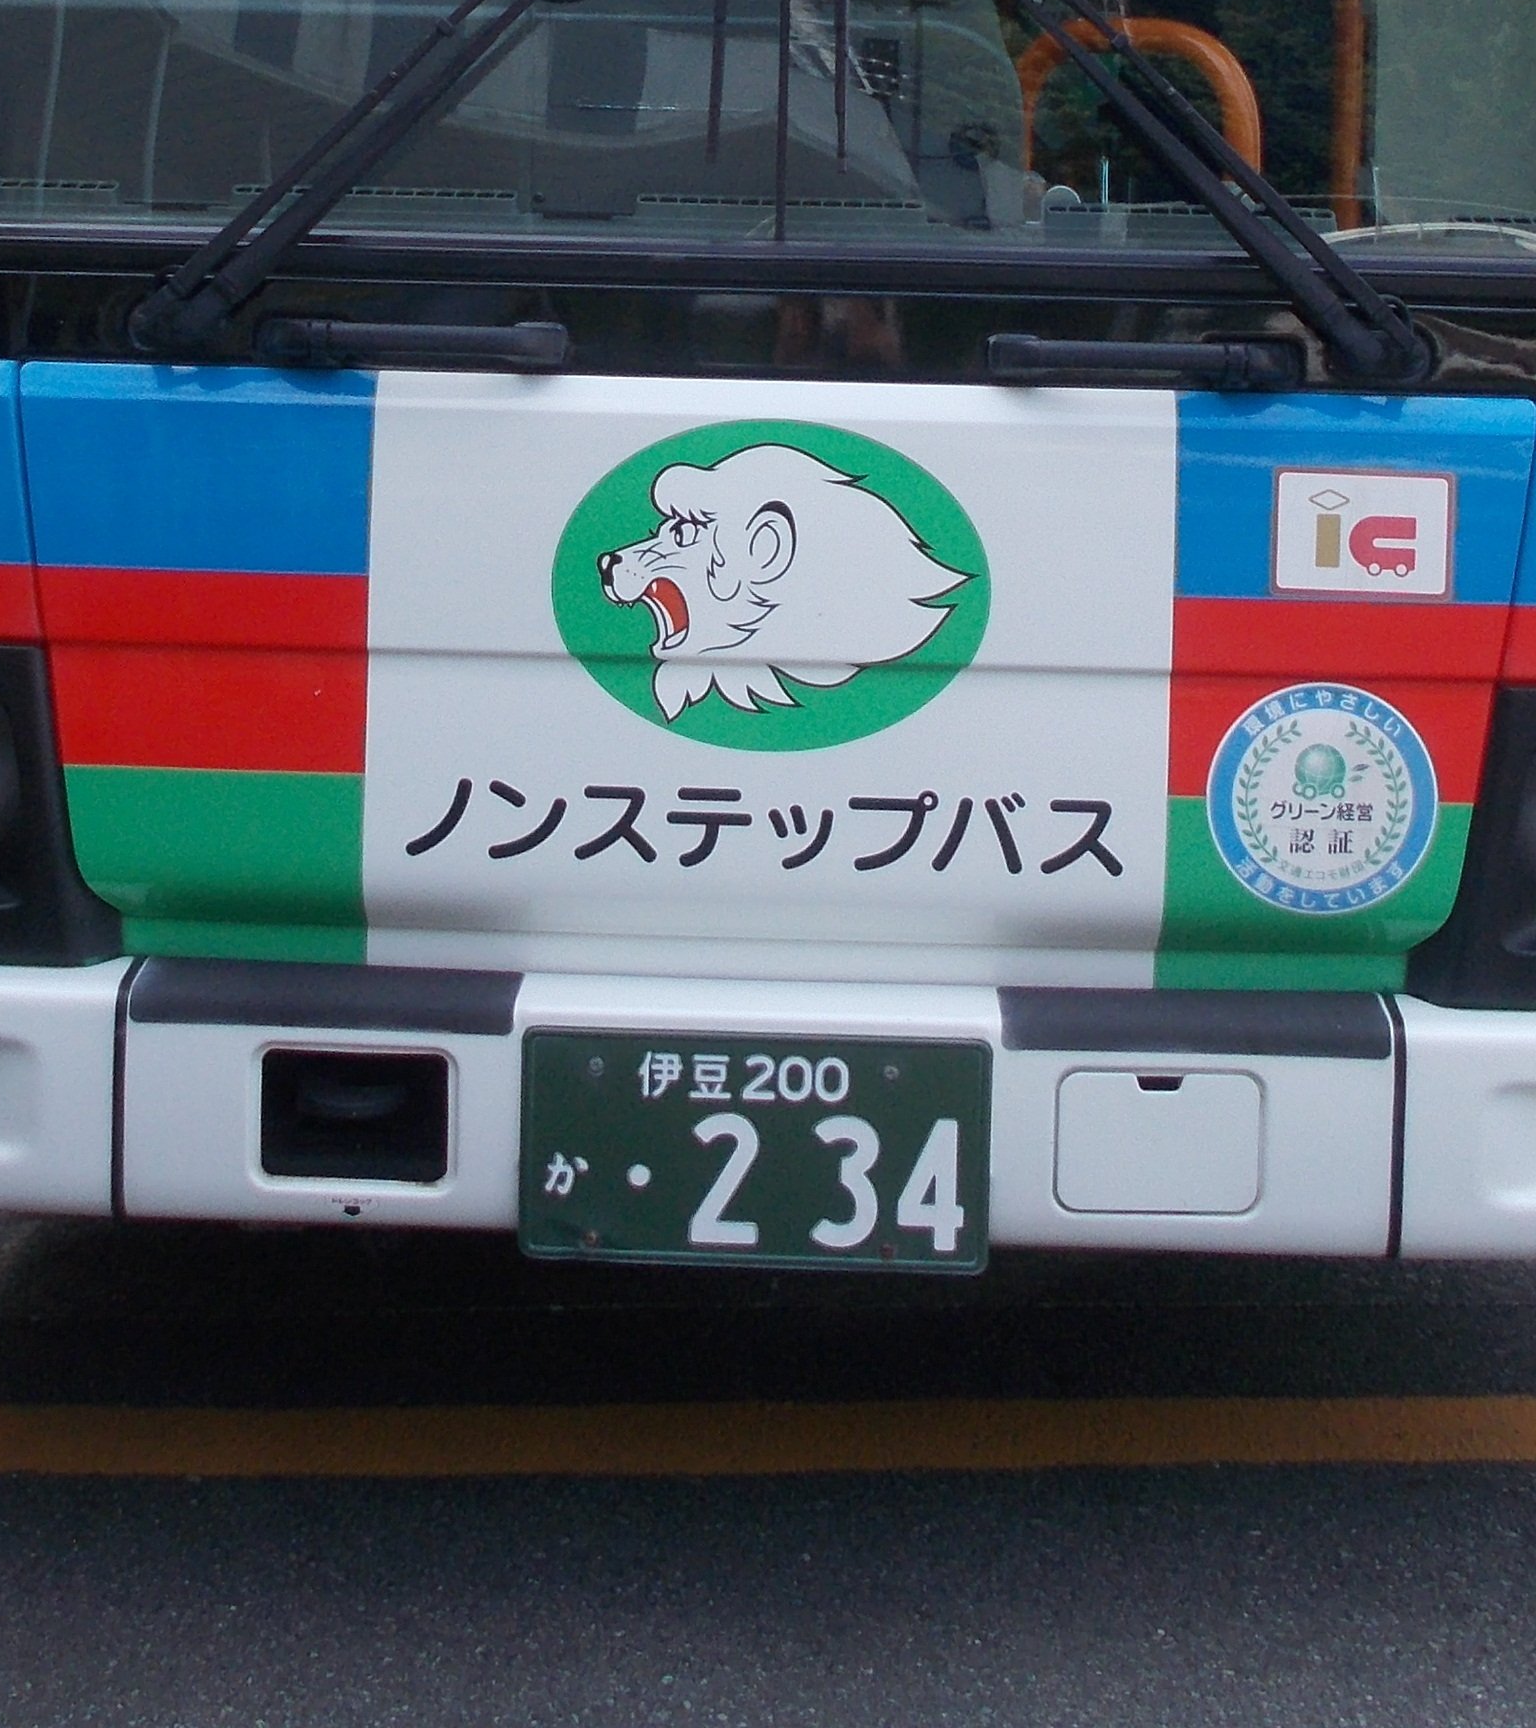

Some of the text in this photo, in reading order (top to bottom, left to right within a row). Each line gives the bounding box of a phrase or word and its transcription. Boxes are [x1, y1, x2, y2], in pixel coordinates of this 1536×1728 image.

[1242, 689, 1402, 737] 環境にやさしい
[406, 777, 1124, 877] ノンステップバス
[1270, 801, 1374, 821] グリーン経営
[1289, 828, 1353, 854] 認証
[1237, 856, 1403, 908] 活動をしています
